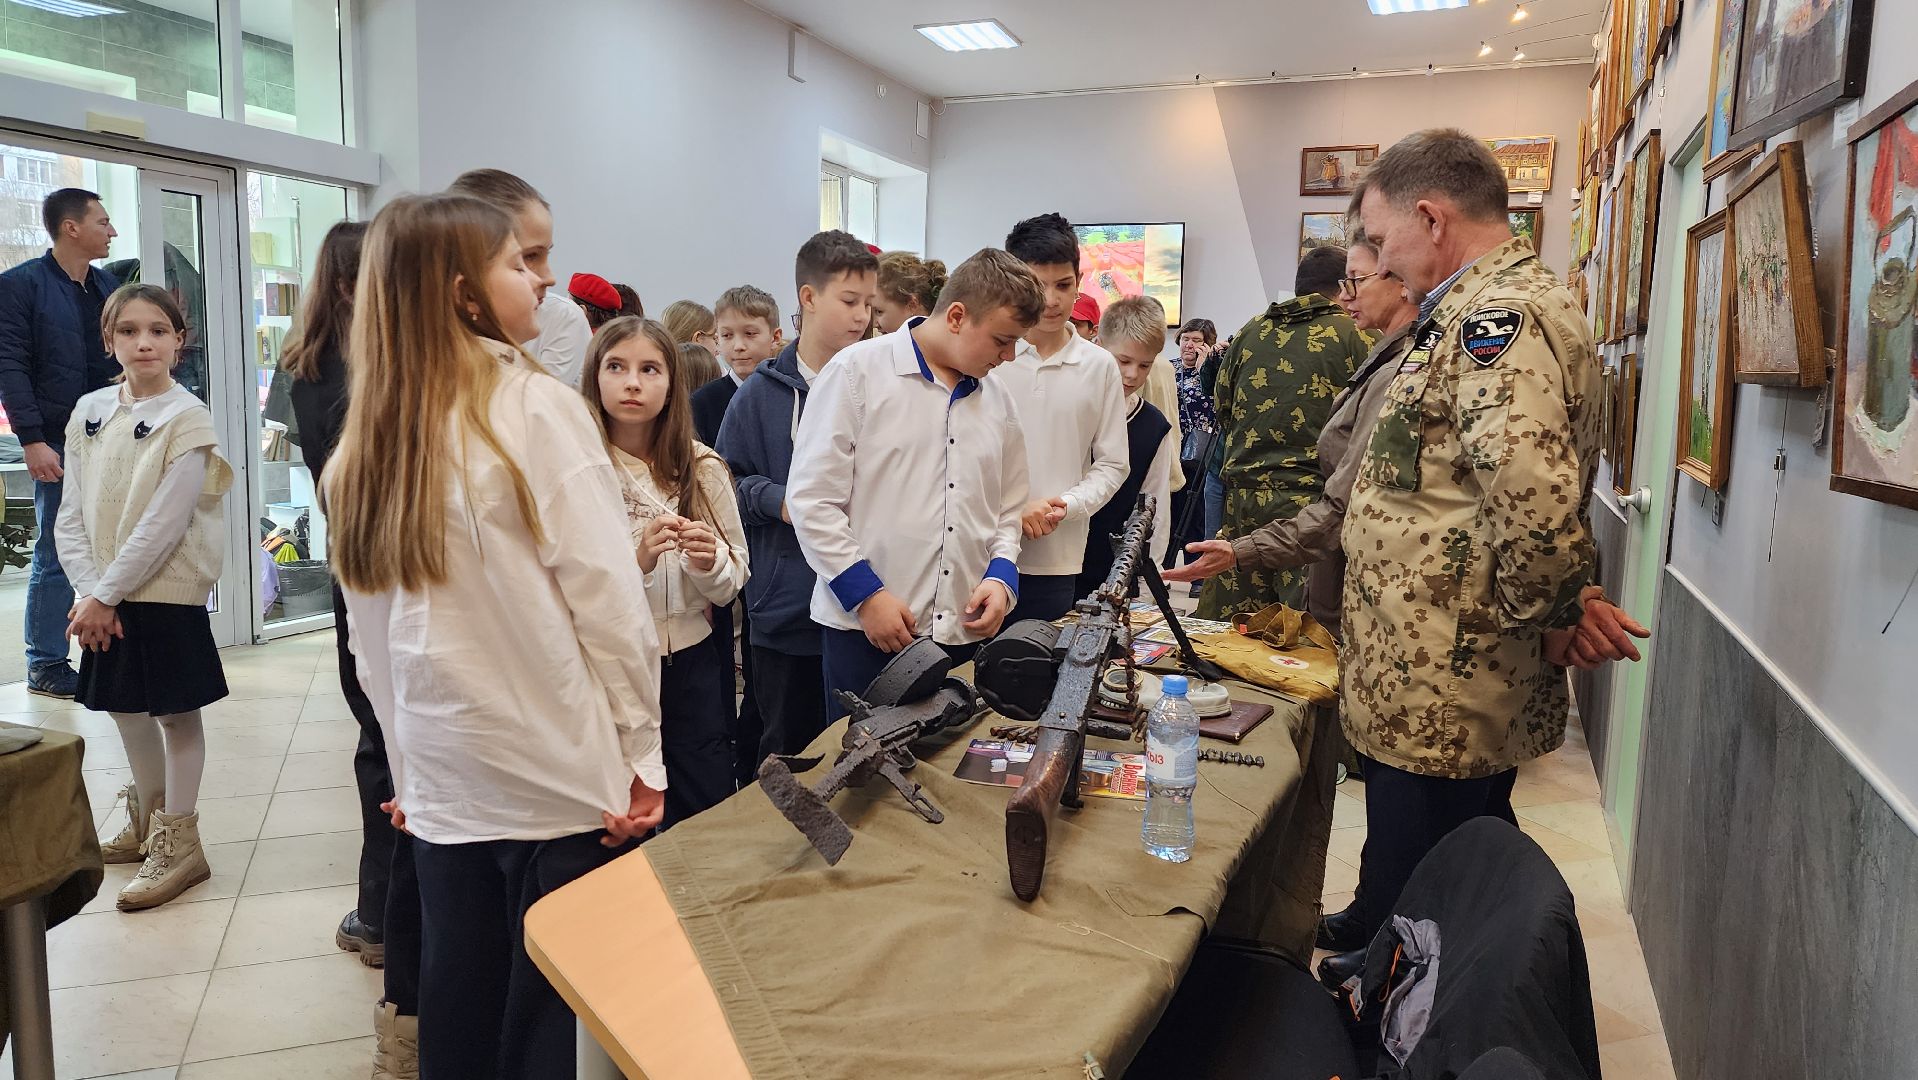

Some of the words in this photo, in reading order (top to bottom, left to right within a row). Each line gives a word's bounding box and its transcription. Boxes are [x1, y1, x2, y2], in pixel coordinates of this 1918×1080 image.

[1469, 311, 1509, 323] ПОИСКОВОЕ
[1469, 337, 1506, 350] ДВИЖЕНИЕ
[1473, 346, 1501, 356] РОССИИ
